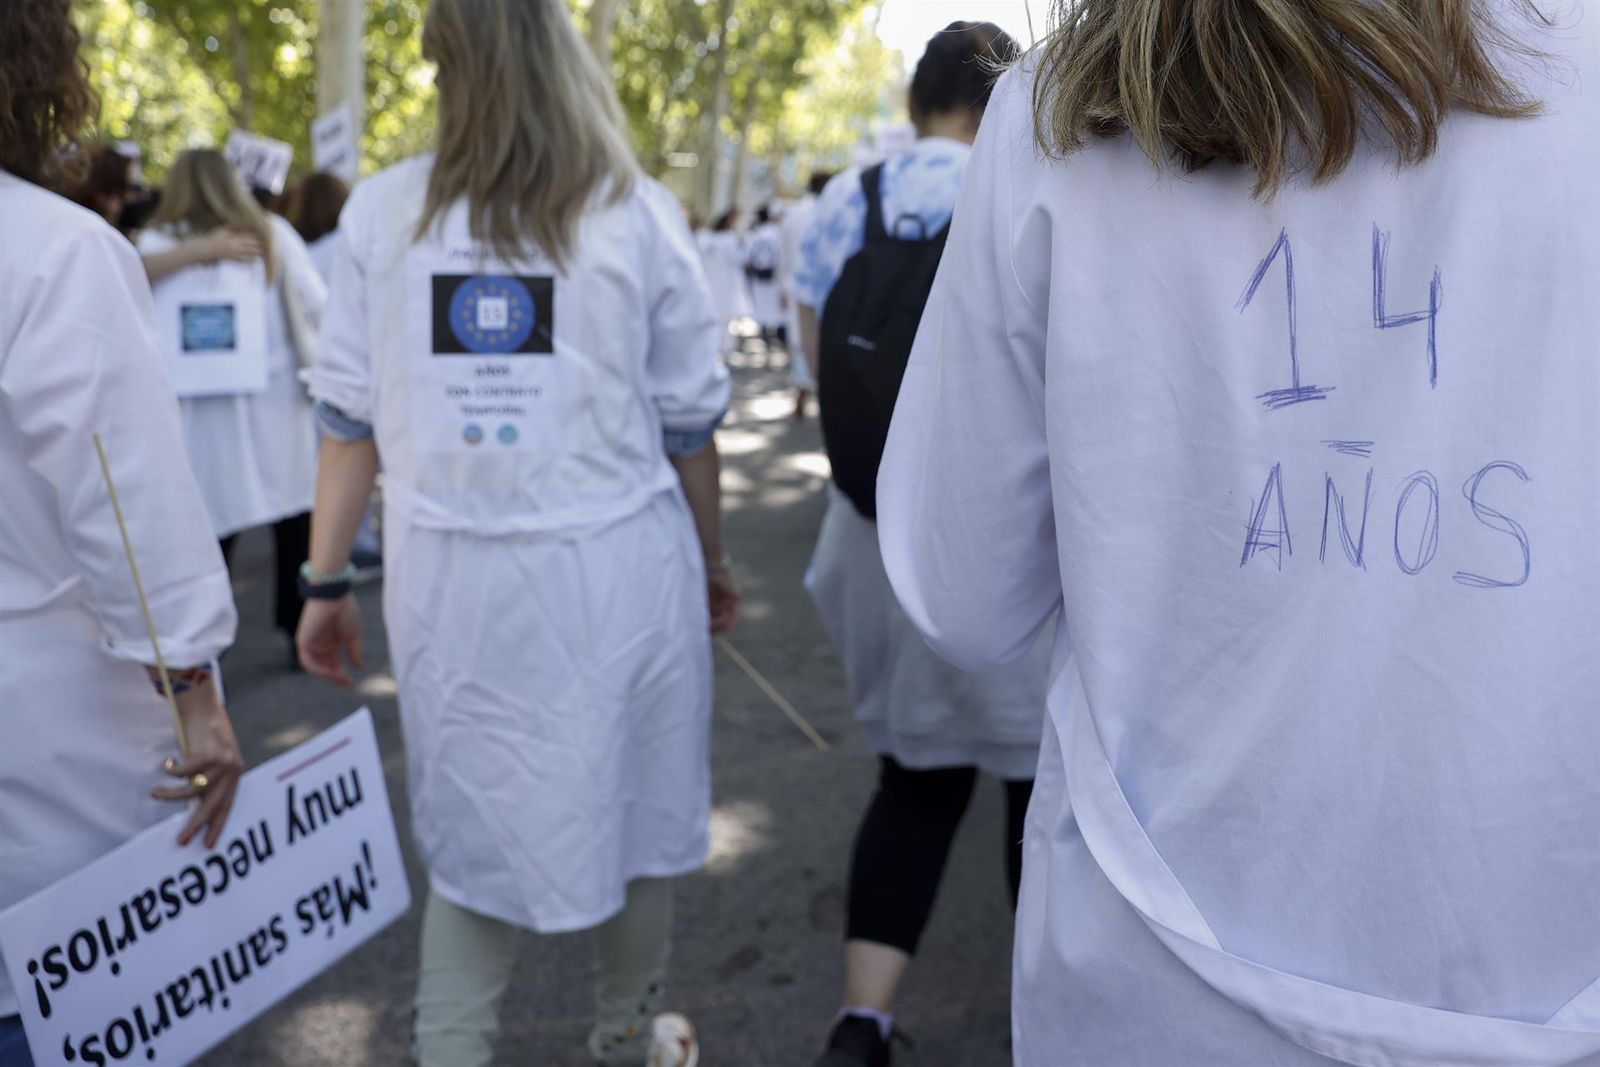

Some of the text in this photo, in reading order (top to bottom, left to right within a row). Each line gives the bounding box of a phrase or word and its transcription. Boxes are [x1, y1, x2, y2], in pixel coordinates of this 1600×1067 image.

[1235, 221, 1443, 411] 14
[1240, 440, 1531, 588] AÑOS
[26, 767, 365, 1019] muy necesarios!
[62, 840, 379, 1067] ¡Más sanitarios,
